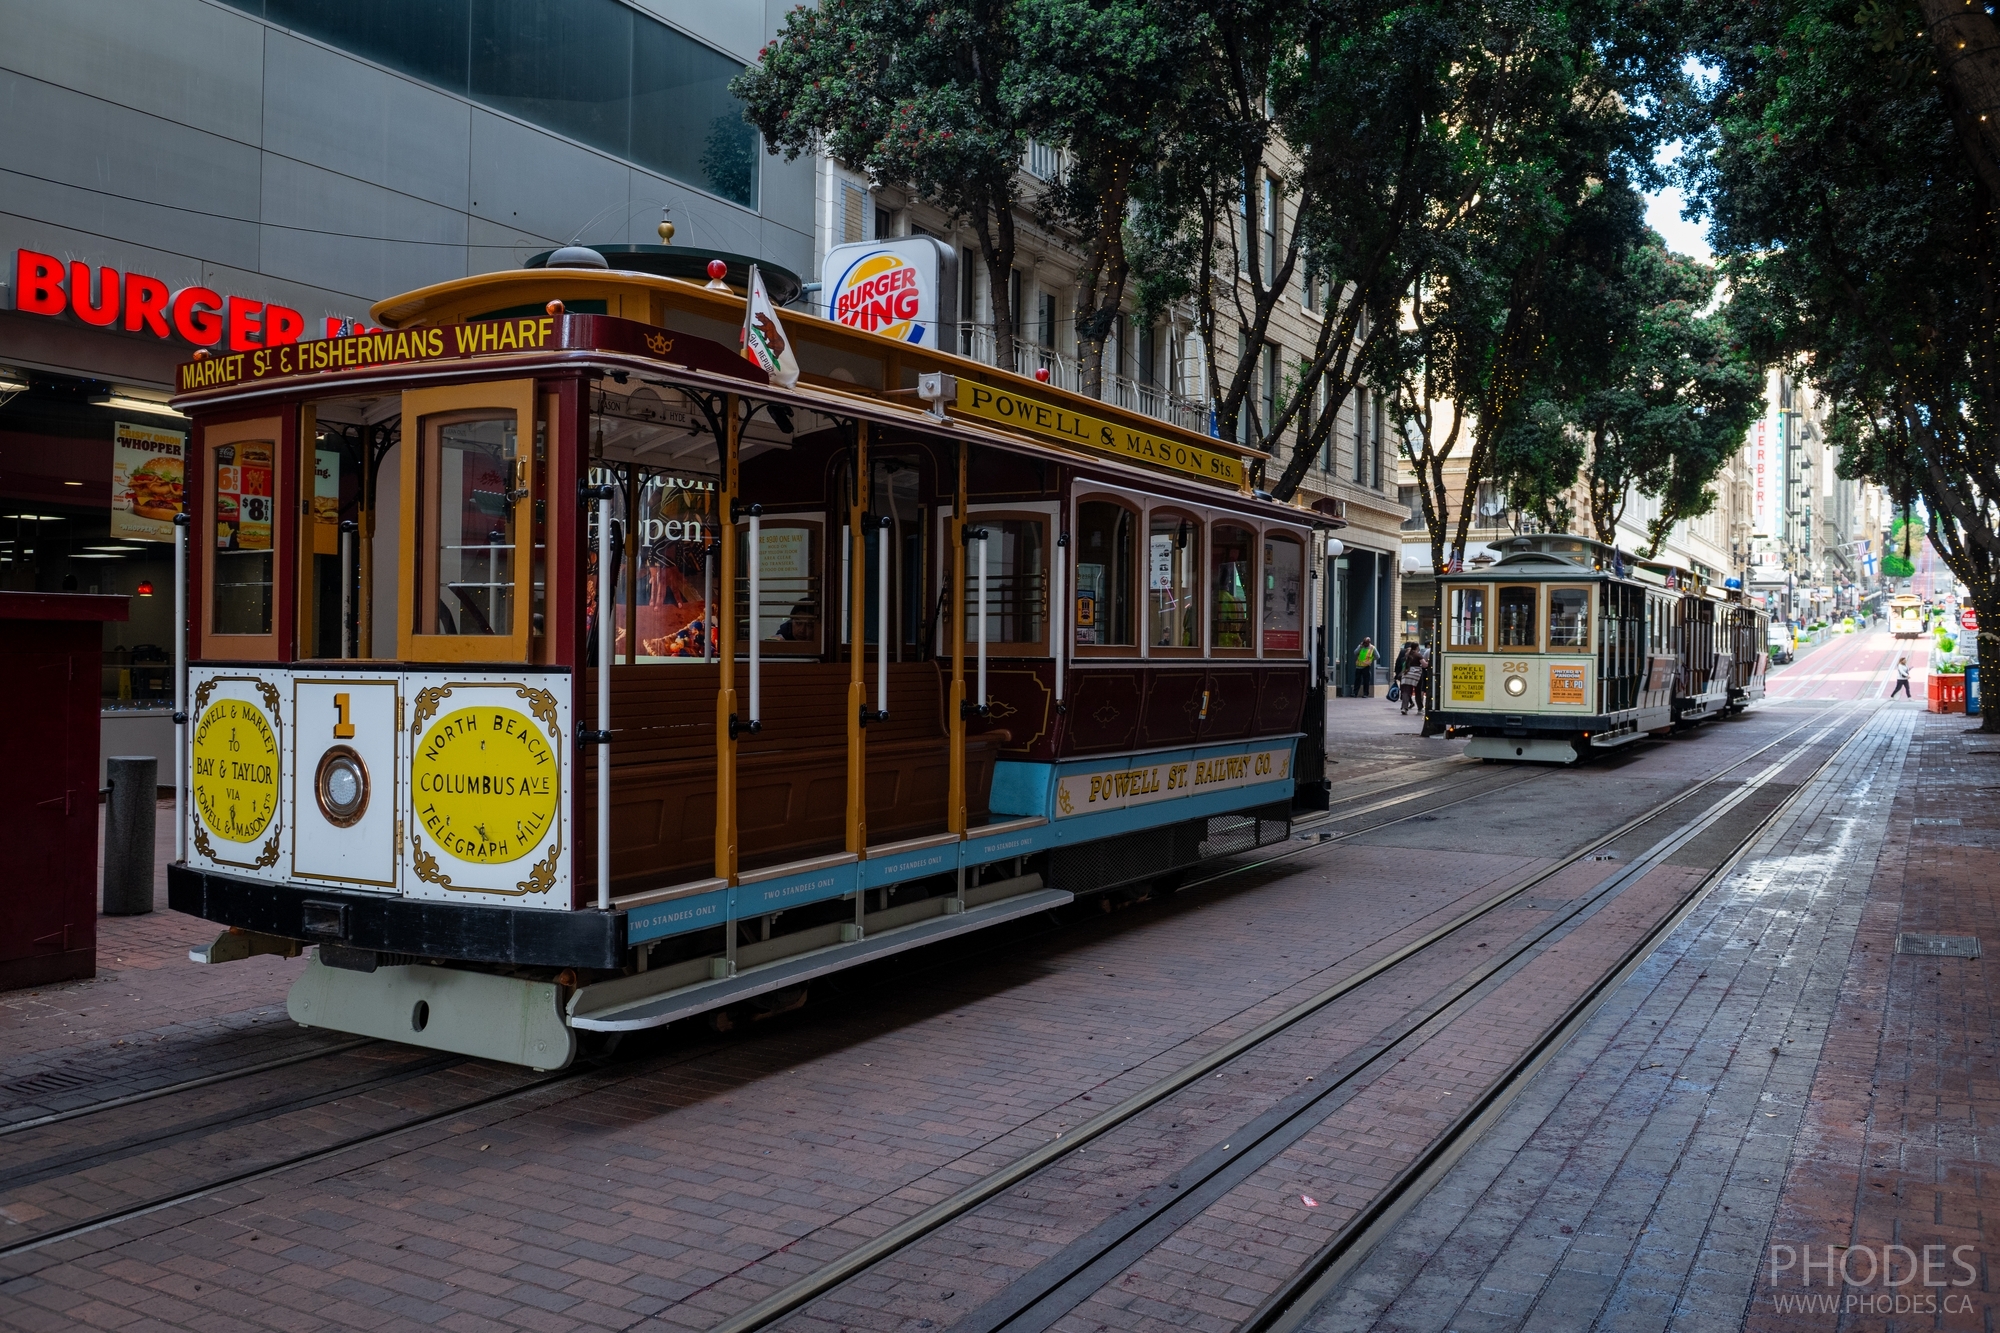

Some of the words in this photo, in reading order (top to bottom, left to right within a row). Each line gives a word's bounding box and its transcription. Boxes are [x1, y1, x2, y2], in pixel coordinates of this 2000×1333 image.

[14, 248, 305, 351] BURGER
[838, 268, 916, 320] BURGER
[182, 354, 243, 390] MARKET
[280, 347, 292, 373] &
[298, 328, 444, 370] FISHERMANS
[454, 318, 554, 354] WHARF
[670, 412, 686, 423] HYDE
[119, 429, 152, 441] CRISPY
[154, 434, 181, 445] ONION
[972, 387, 1090, 439] POWELL
[1100, 426, 1116, 448] &
[1126, 433, 1202, 468] MASON
[1211, 462, 1234, 478] Sts.
[117, 437, 181, 456] WHOPPER
[1757, 422, 1765, 516] HERBERT
[242, 497, 264, 521] $8
[1502, 662, 1528, 673] 26
[333, 693, 356, 739] 1
[1198, 690, 1210, 719] 1
[197, 705, 227, 746] POWELL
[231, 705, 238, 718] &
[242, 706, 274, 756] MARKET
[425, 715, 476, 761] NORTH
[493, 715, 549, 766] BEACH
[229, 740, 240, 752] TO
[196, 758, 213, 775] BAY
[219, 760, 227, 777] &
[231, 762, 273, 784] TAYLOR
[420, 772, 515, 795] COLUMBUS
[1088, 768, 1160, 802] POWELL
[1167, 764, 1188, 790] ST.
[1195, 756, 1251, 785] RAILWAY
[1254, 753, 1272, 775] CO.
[226, 788, 240, 800] VIA
[198, 784, 221, 831] POWELL
[224, 819, 231, 833] &
[235, 812, 266, 837] MASON
[422, 803, 508, 857] TELEGRAPH
[517, 811, 545, 846] HILL
[984, 845, 995, 853] TWO
[885, 865, 898, 874] TWO
[900, 859, 926, 871] STANDEES
[928, 856, 942, 865] ONLY
[764, 888, 780, 900] TWO
[782, 882, 815, 896] STANDEES
[818, 878, 835, 888] ONLY
[630, 918, 650, 931] TWO
[653, 909, 693, 927] STANDEES
[696, 904, 716, 918] ONLY
